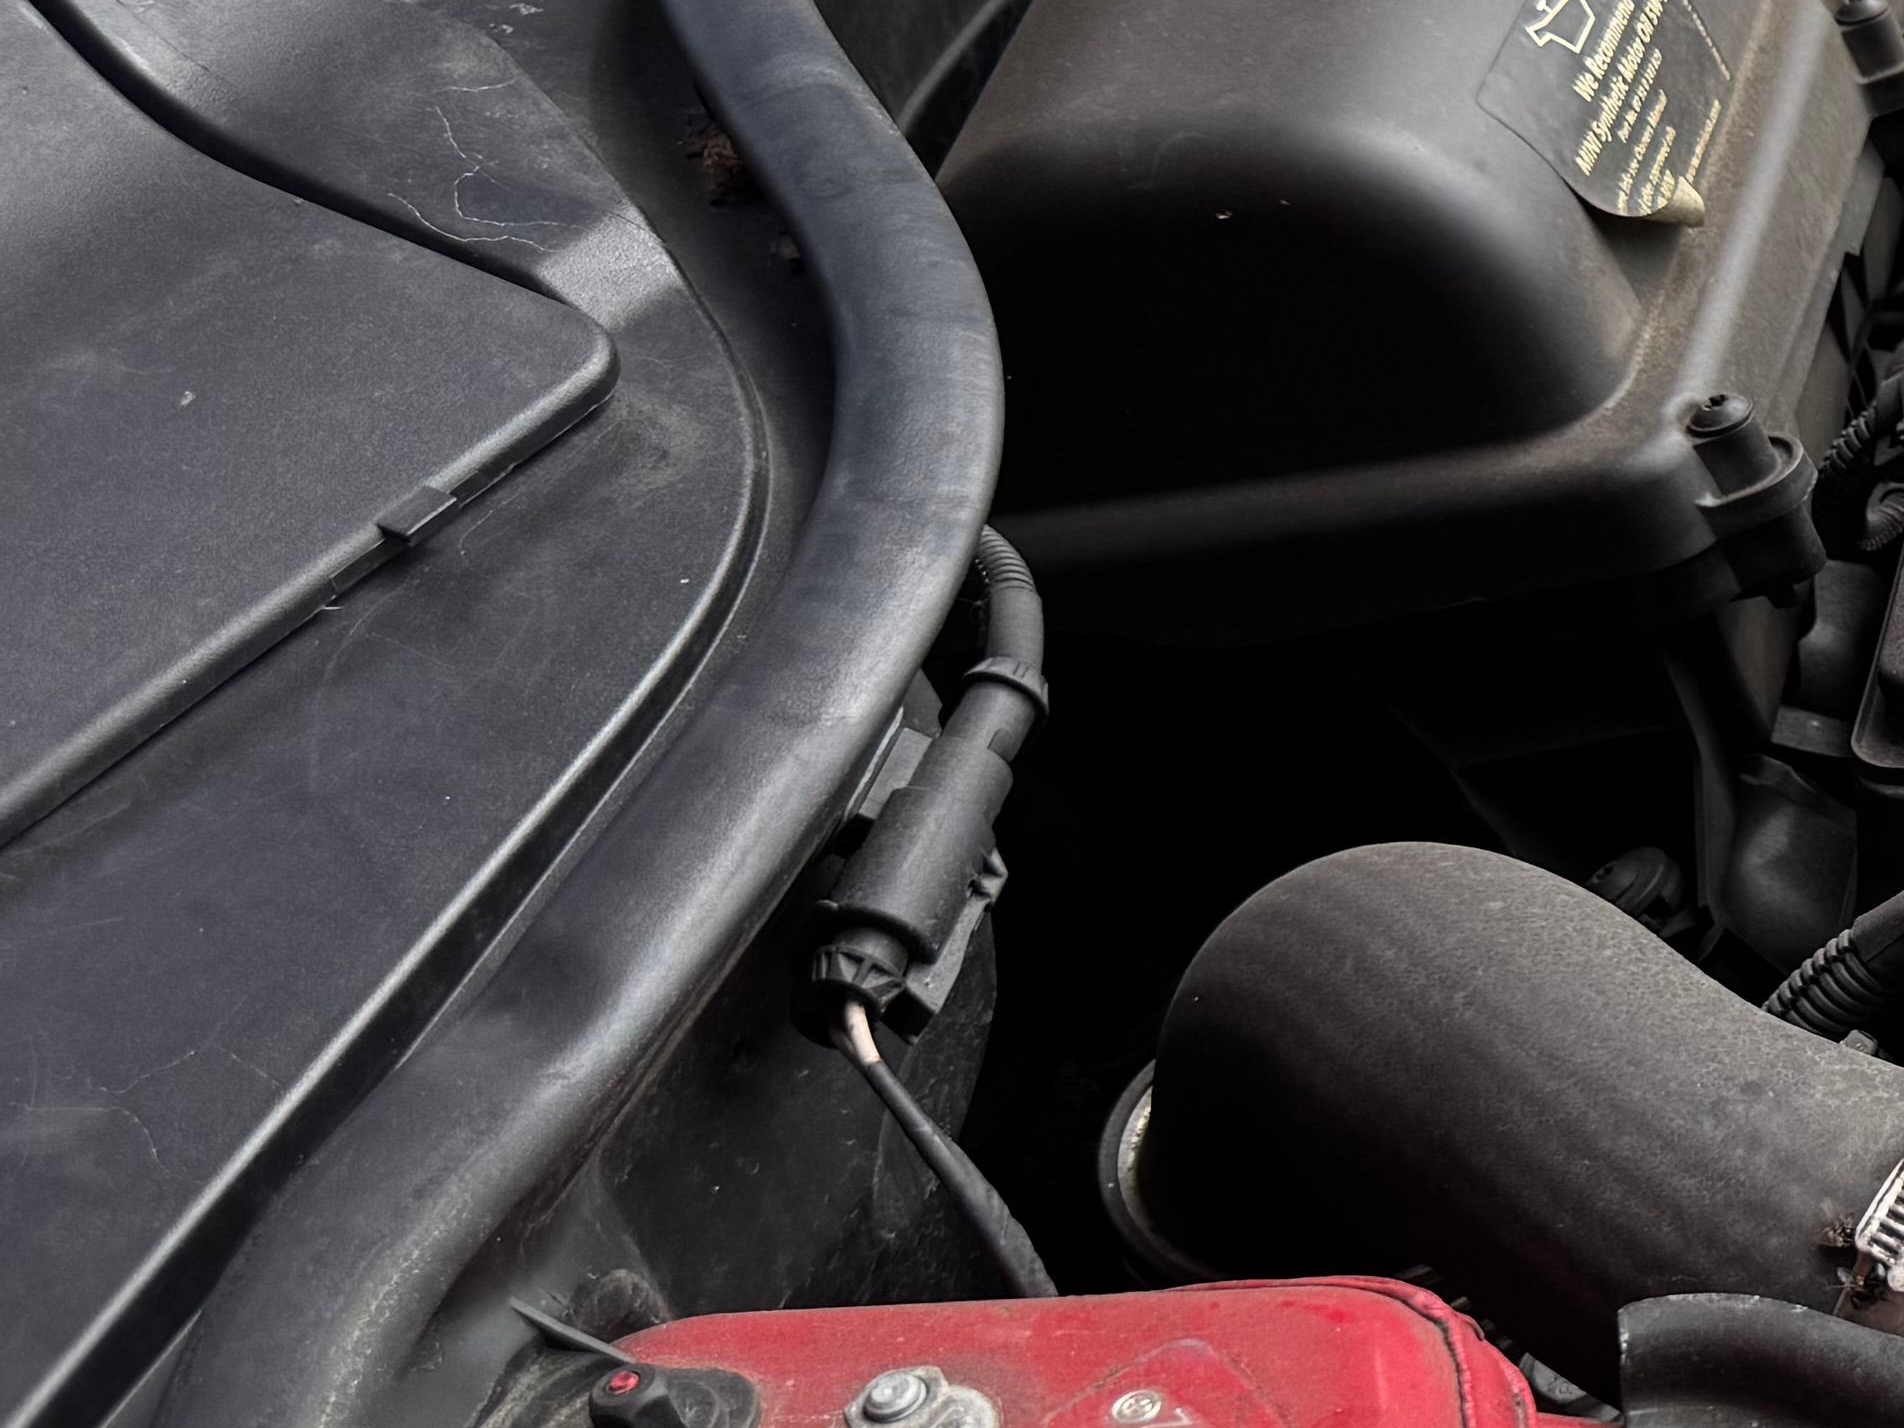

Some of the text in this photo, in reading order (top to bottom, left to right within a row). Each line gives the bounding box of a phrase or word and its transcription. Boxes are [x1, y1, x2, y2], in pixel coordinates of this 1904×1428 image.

[1573, 72, 1599, 102] We
[1575, 130, 1602, 176] MINI
[1592, 75, 1629, 142] Synthetic
[1617, 37, 1645, 83] Motor
[1636, 12, 1654, 43] Oil
